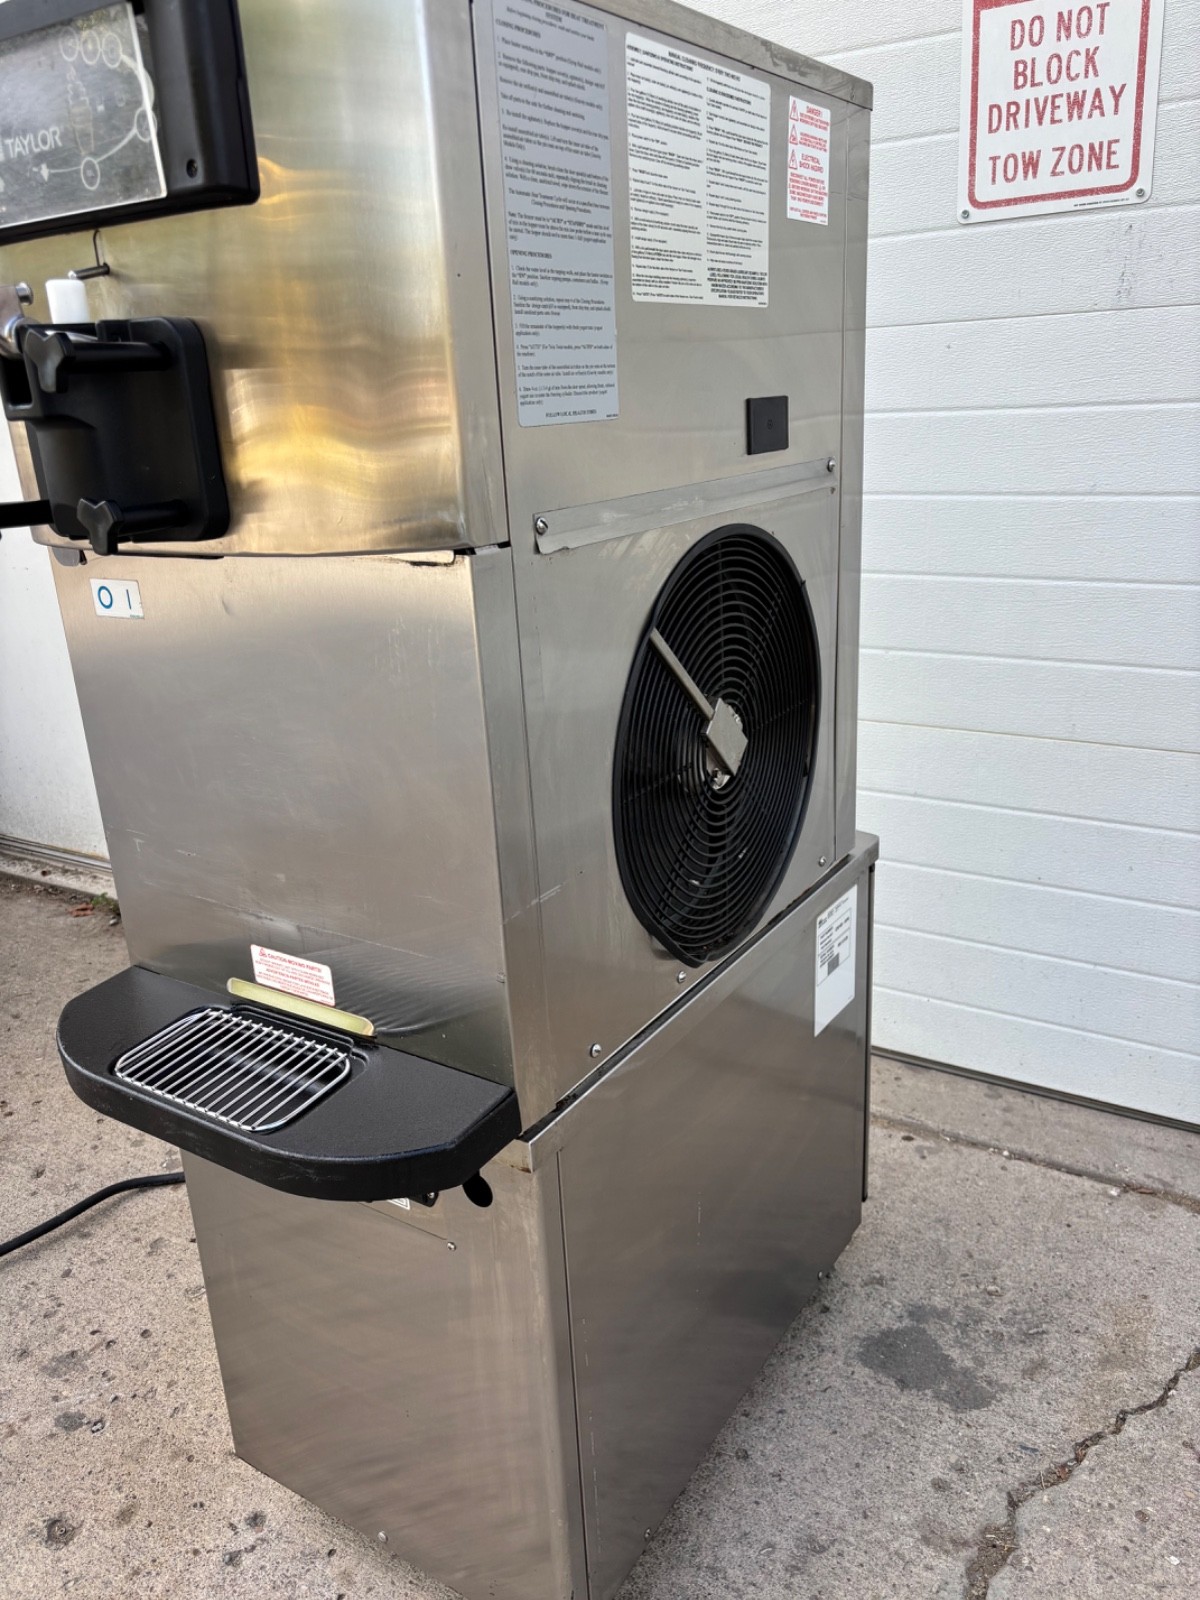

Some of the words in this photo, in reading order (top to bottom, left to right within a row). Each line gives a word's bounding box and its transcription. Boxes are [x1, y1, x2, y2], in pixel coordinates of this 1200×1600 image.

[1010, 14, 1045, 51] DO
[1056, 1, 1111, 42] NOT
[1013, 45, 1100, 91] BLOCK
[987, 83, 1127, 135] DRIVEWAY
[4, 127, 63, 158] TAYLOR
[988, 149, 1042, 186] TOW
[1050, 138, 1121, 177] ZONE
